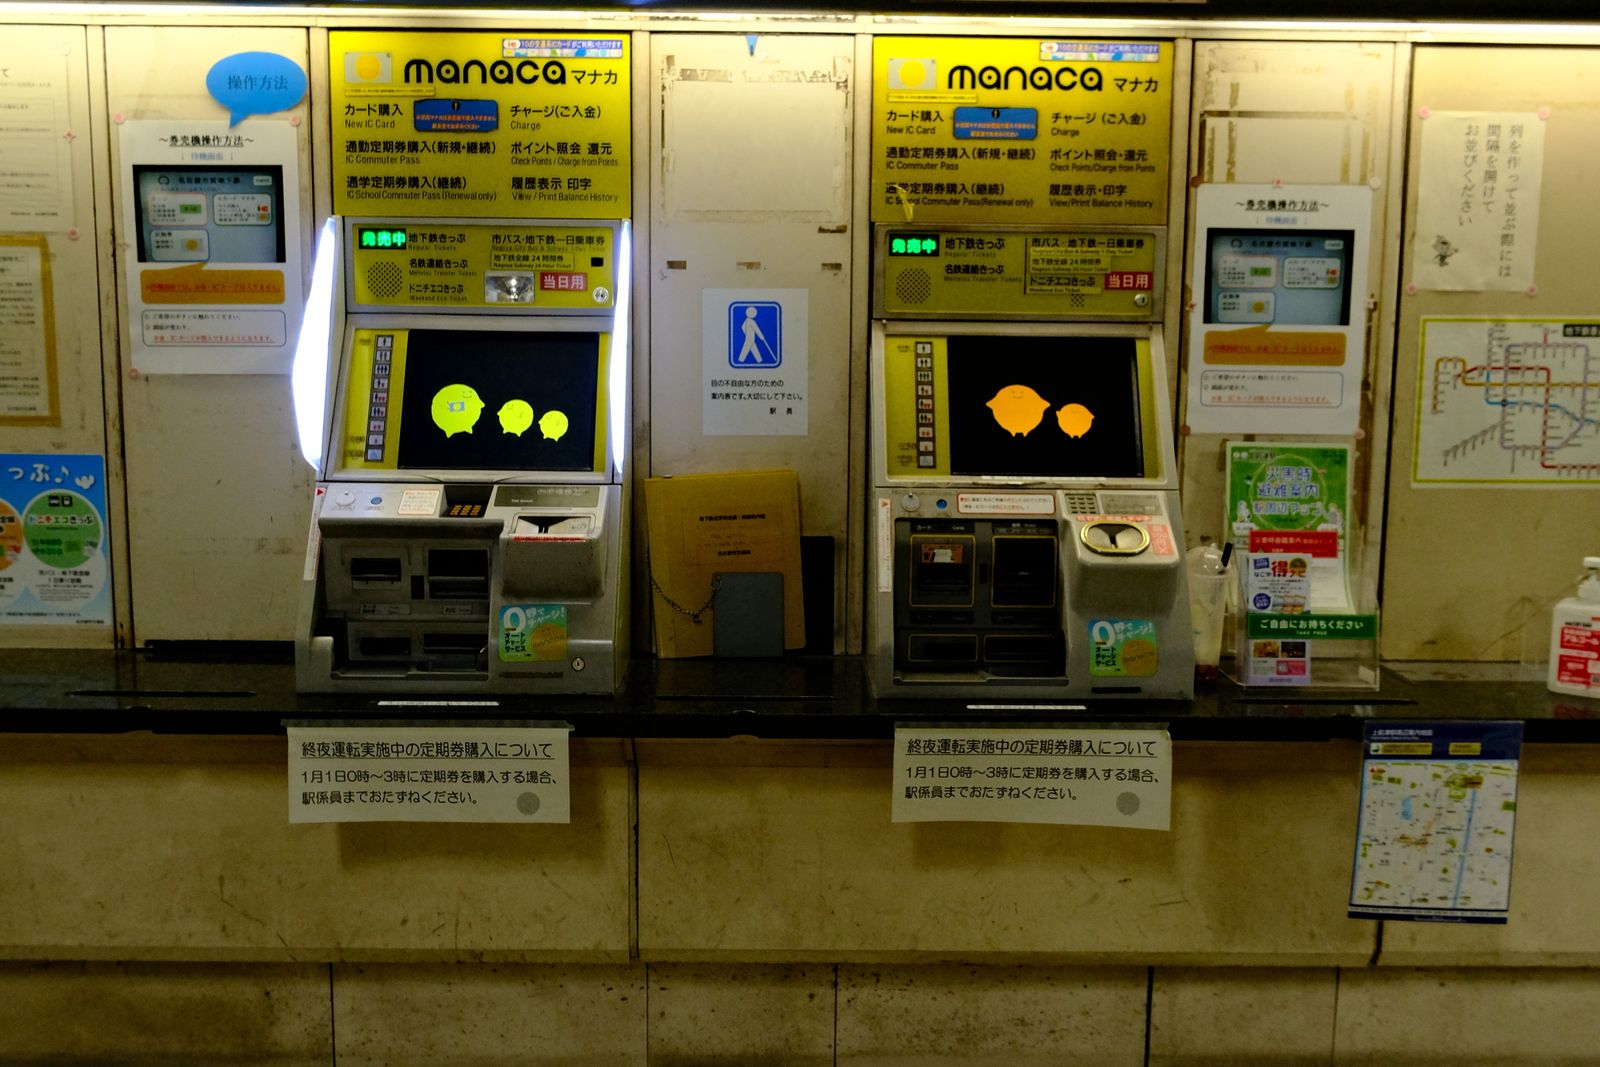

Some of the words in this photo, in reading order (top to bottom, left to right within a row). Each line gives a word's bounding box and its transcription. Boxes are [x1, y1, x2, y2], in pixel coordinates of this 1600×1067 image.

[404, 59, 566, 85] manaca
[571, 70, 618, 85] マナカ
[227, 75, 288, 91] 操作方法
[948, 65, 1103, 91] manaca
[1113, 77, 1158, 93] マナカ
[344, 103, 403, 116] カード購入
[510, 106, 601, 119] チャージ(ご入金)
[886, 110, 944, 122] カード購入
[1051, 113, 1146, 126] チャージ(ご入金)
[345, 119, 363, 129] New
[365, 119, 374, 129] IC
[376, 120, 395, 129] Card
[510, 120, 541, 130] Charge
[886, 126, 904, 135] New
[905, 126, 914, 135] IC
[916, 126, 935, 135] Card
[1051, 128, 1080, 138] Charge
[345, 140, 497, 155] 通勤定期券購入(新規・継続)
[511, 142, 581, 155] ポイント照会
[588, 143, 613, 155] 還元
[886, 146, 1036, 160] 通勤定期券購入(新規・継続)
[345, 155, 353, 165] IC
[355, 155, 398, 165] Commuter
[400, 156, 420, 165] Pass
[1050, 149, 1147, 162] ポイント照会・還元
[511, 157, 529, 166] Check
[557, 158, 580, 167] Charge
[598, 158, 618, 167] Points
[886, 161, 894, 170] IC
[896, 161, 938, 171] Commuter
[941, 162, 959, 171] Pass
[1482, 124, 1501, 214] 間隔を開けて
[1459, 124, 1479, 227] お並びください
[346, 176, 467, 189] 通学定期券購入(継続)
[511, 177, 563, 190] 履歴表示
[567, 178, 592, 190] 印字
[346, 190, 354, 199] IC
[355, 190, 381, 200] School
[382, 191, 421, 201] Commuter
[422, 191, 441, 200] Pass
[1049, 184, 1127, 196] 履歴表示・印字
[512, 192, 531, 201] View
[538, 192, 557, 202] Print
[558, 193, 589, 202] Balance
[591, 194, 618, 203] History
[1498, 124, 1524, 277] 列を作って並ぶ際には
[1091, 199, 1124, 208] Balance
[1125, 199, 1154, 209] History
[408, 233, 466, 244] 地下鉄きっぷ
[492, 234, 605, 246] 市バス・地下鉄一日乗車券
[945, 238, 1006, 250] 地下鉄きっぷ
[1032, 238, 1144, 249] 市バス・地下鉄一日乗車券
[410, 258, 468, 269] 名鉄連絡きっぷ
[945, 264, 1004, 275] 名鉄連絡きっぷ
[543, 275, 585, 289] 当日用
[1030, 276, 1096, 287] ドニチエコきっぷ
[1108, 273, 1149, 288] 当日用
[409, 284, 464, 294] ドニチエコきっぷ
[711, 379, 784, 388] 目の不自由な方のための
[29, 515, 93, 524] ドニチエコきっぷ
[1260, 619, 1363, 630] ご自由にお持ちください
[302, 741, 552, 758] 終夜運転実施中の定期券購入について
[907, 738, 1158, 756] 終夜運転実施中の定期券購入について
[302, 790, 478, 805] 駅係員までおたずねください。
[904, 785, 1077, 800] 駅係員までおたずねください。
